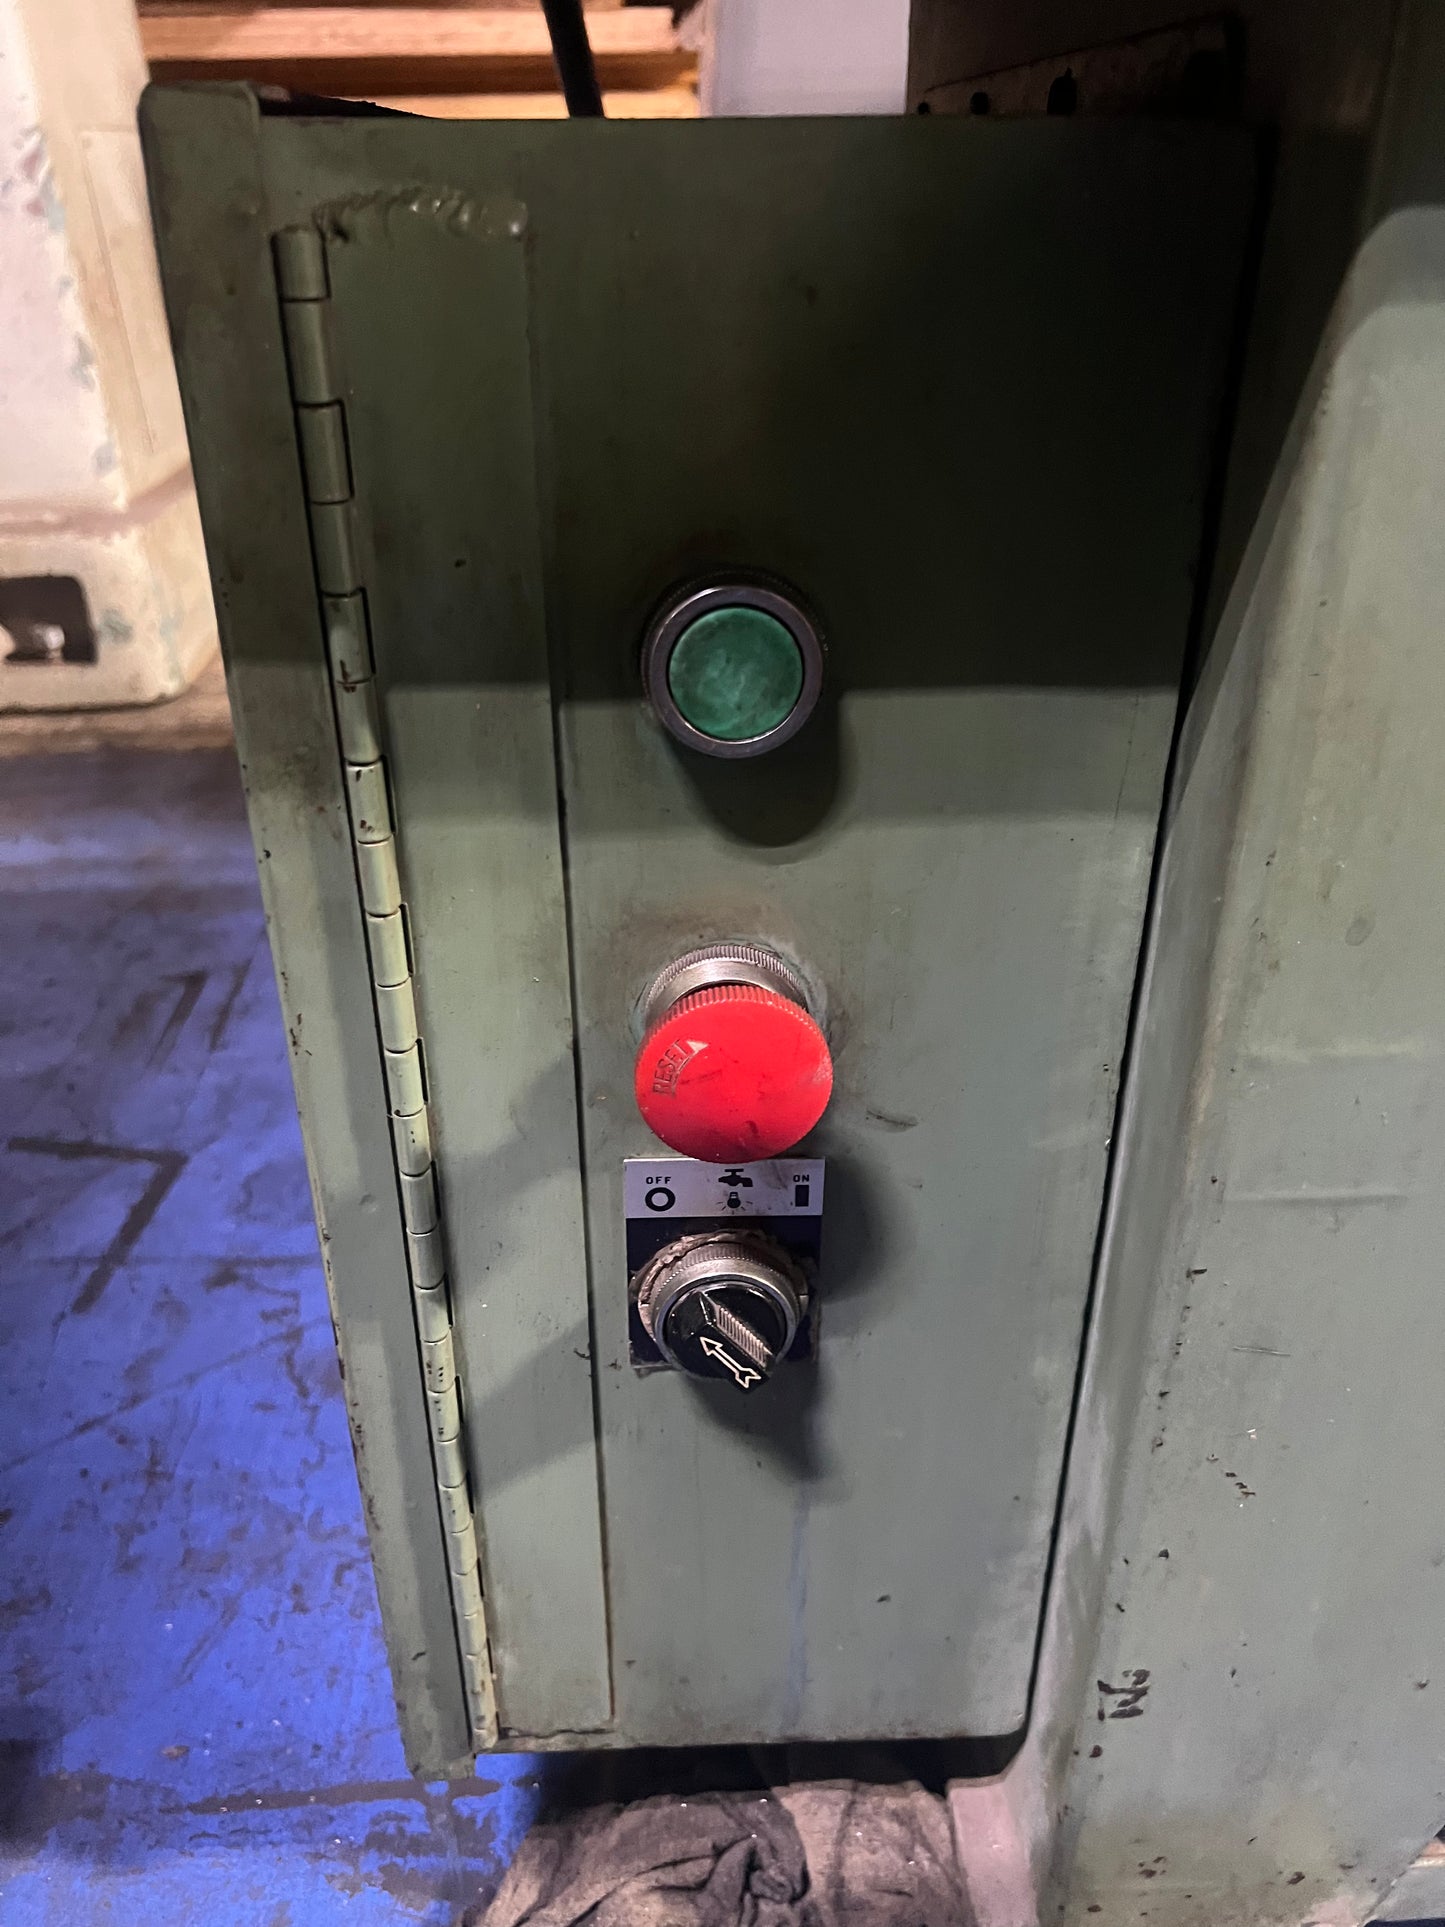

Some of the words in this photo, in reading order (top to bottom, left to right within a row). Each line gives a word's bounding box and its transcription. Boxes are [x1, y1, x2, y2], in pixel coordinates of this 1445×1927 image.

[652, 1039, 688, 1096] RESET
[645, 1176, 672, 1185] OFF
[792, 1174, 810, 1183] ON
